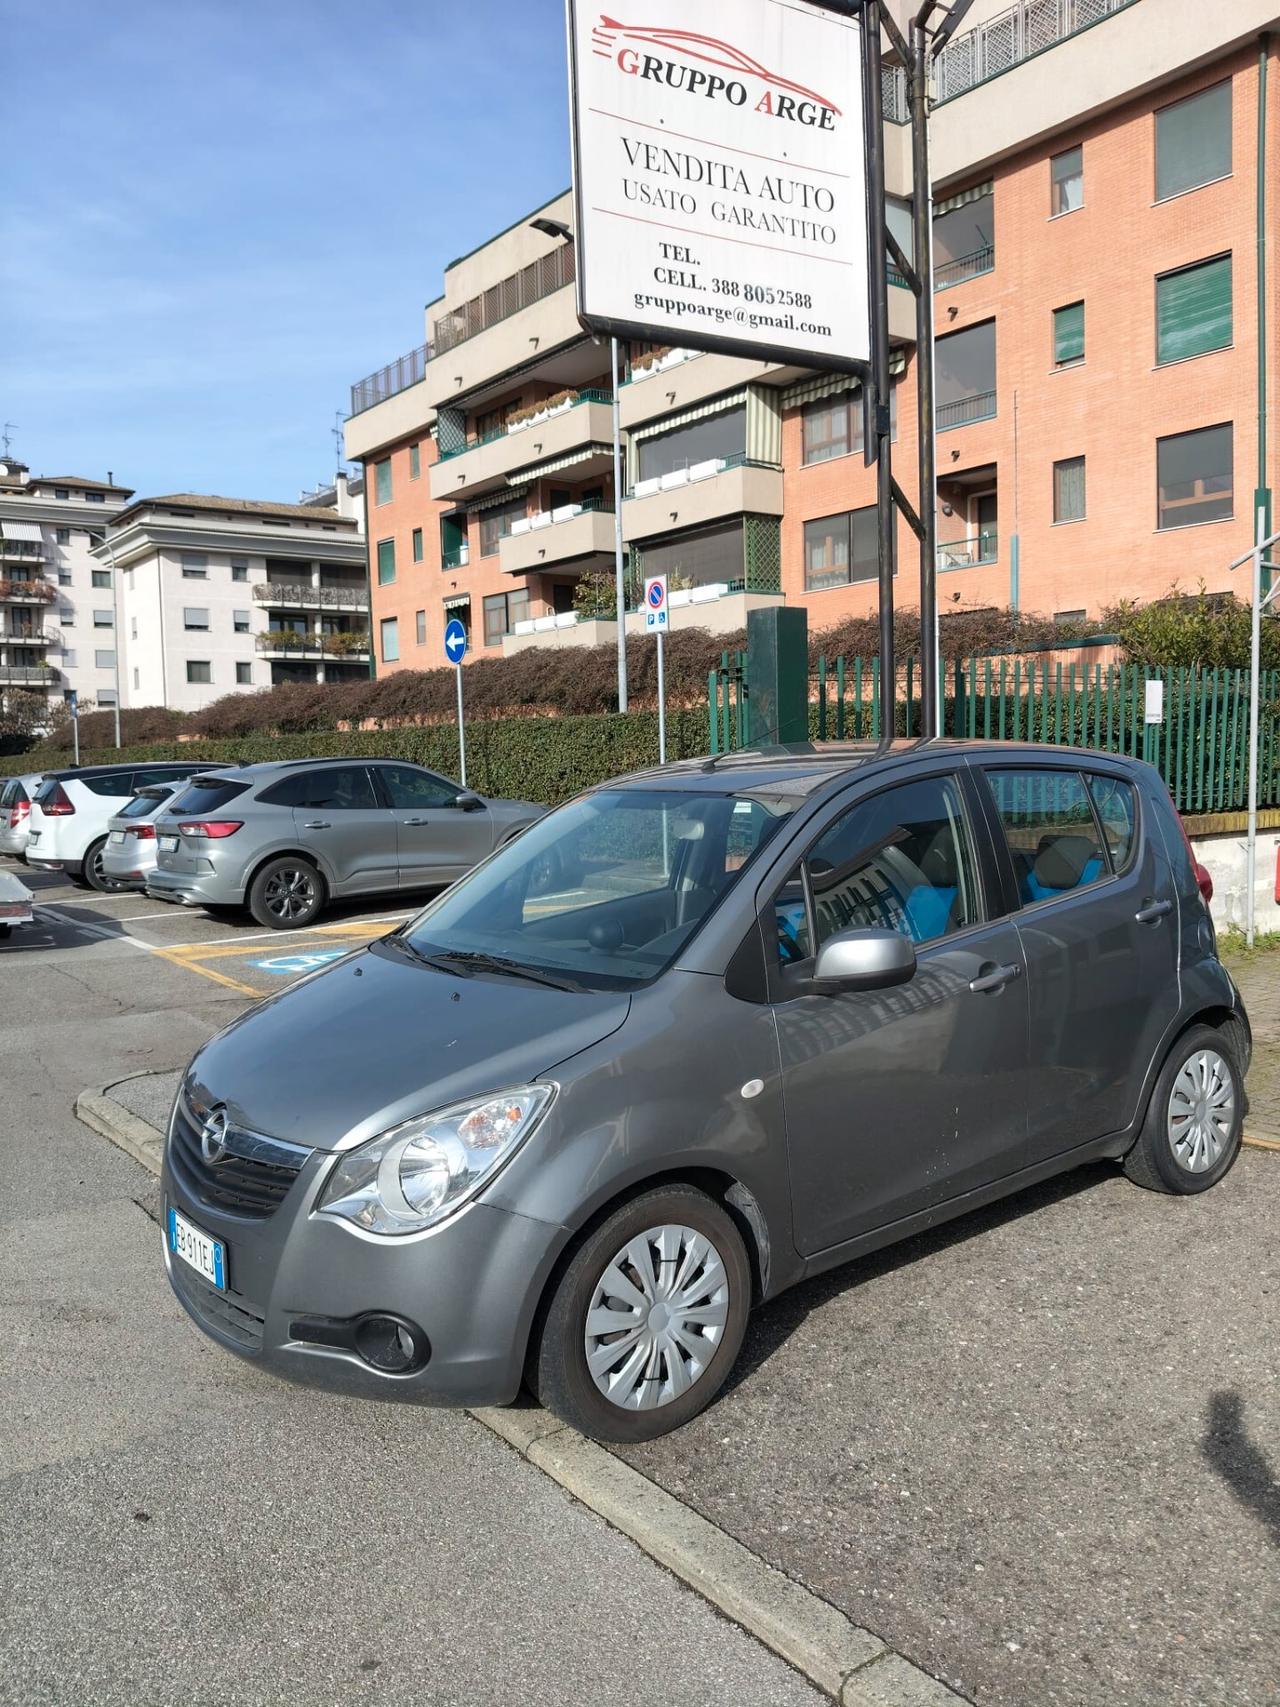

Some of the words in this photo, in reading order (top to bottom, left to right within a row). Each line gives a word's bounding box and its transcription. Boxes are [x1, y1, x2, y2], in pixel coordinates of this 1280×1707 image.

[617, 48, 747, 106] GRUPPO
[754, 91, 836, 131] ARGE
[620, 136, 752, 196] VENDITA
[758, 175, 835, 213] AUTO
[622, 178, 697, 214] USATO
[711, 201, 836, 244] GARANTITO
[658, 242, 701, 266] TEL.
[653, 266, 707, 291] CELL.
[711, 278, 740, 297] 388
[634, 293, 832, 336] gruppoarge@gmail.com
